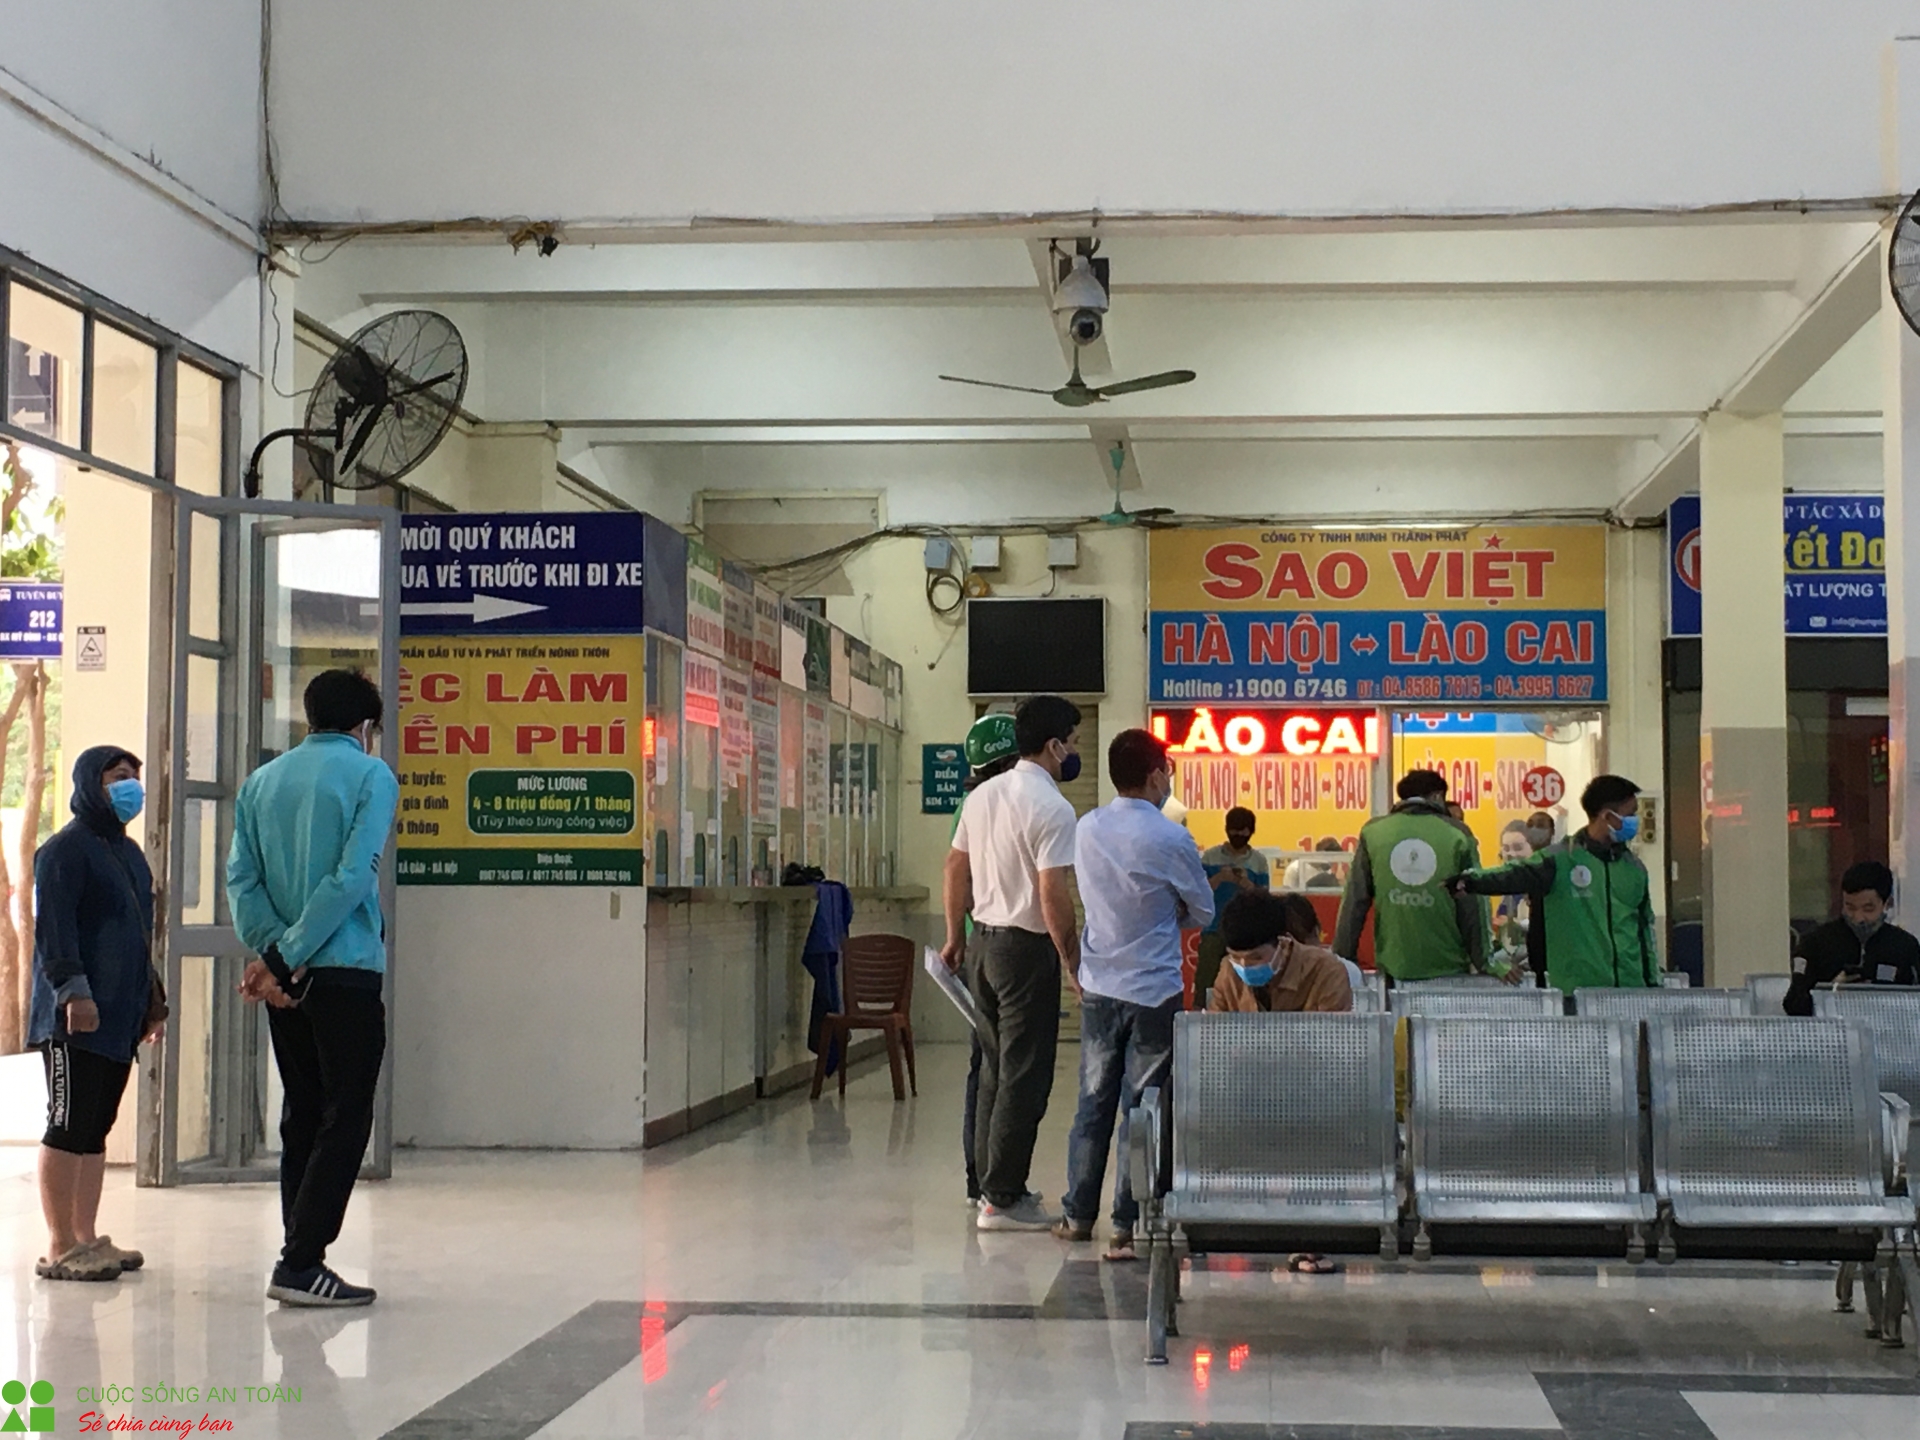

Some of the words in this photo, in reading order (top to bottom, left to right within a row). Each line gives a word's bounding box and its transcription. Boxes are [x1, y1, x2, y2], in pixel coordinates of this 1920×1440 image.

[1796, 502, 1834, 519] TÁC
[1839, 502, 1864, 519] XÃ
[401, 521, 441, 551] MỜI
[449, 522, 493, 552] QUÝ
[500, 521, 575, 549] KHÁCH
[1261, 530, 1296, 543] CÔNG
[1301, 532, 1315, 543] TY
[1319, 532, 1351, 543] TNHH
[1355, 532, 1387, 542] MINH
[436, 560, 461, 588] VÉ
[468, 558, 537, 587] TRƯỚC
[544, 563, 579, 586] KHI
[587, 563, 609, 586] ĐI
[615, 563, 642, 586] XE
[1201, 541, 1369, 601] SAO
[1389, 534, 1556, 606] VIỆT
[1809, 583, 1874, 600] LƯỢNG
[29, 610, 56, 628] 212
[1162, 613, 1233, 665] HÀ
[1249, 614, 1340, 674] NỘI
[1388, 613, 1488, 665] LÀO
[1505, 620, 1594, 664] CAI
[485, 666, 628, 703] LÀM
[1163, 679, 1223, 698] Hotline
[1294, 679, 1347, 697] 6746
[1382, 675, 1440, 698] 04.8586
[1444, 675, 1480, 698] 7815
[1494, 675, 1553, 698] 04.3995
[1557, 675, 1593, 698] 8627
[515, 718, 626, 755] PHÍ
[1152, 707, 1266, 756] LÀO
[1281, 714, 1380, 756] CAI
[983, 737, 1012, 754] Grab
[517, 775, 545, 791] MỨC
[548, 776, 587, 791] LƯƠNG
[1452, 760, 1480, 810] CAI
[1526, 772, 1562, 803] 36
[505, 796, 536, 813] triệu
[539, 794, 571, 812] đồng
[584, 796, 590, 810] 1
[595, 796, 631, 812] tháng
[507, 815, 534, 827] theo
[566, 815, 595, 828] công
[1388, 888, 1435, 908] Grab
